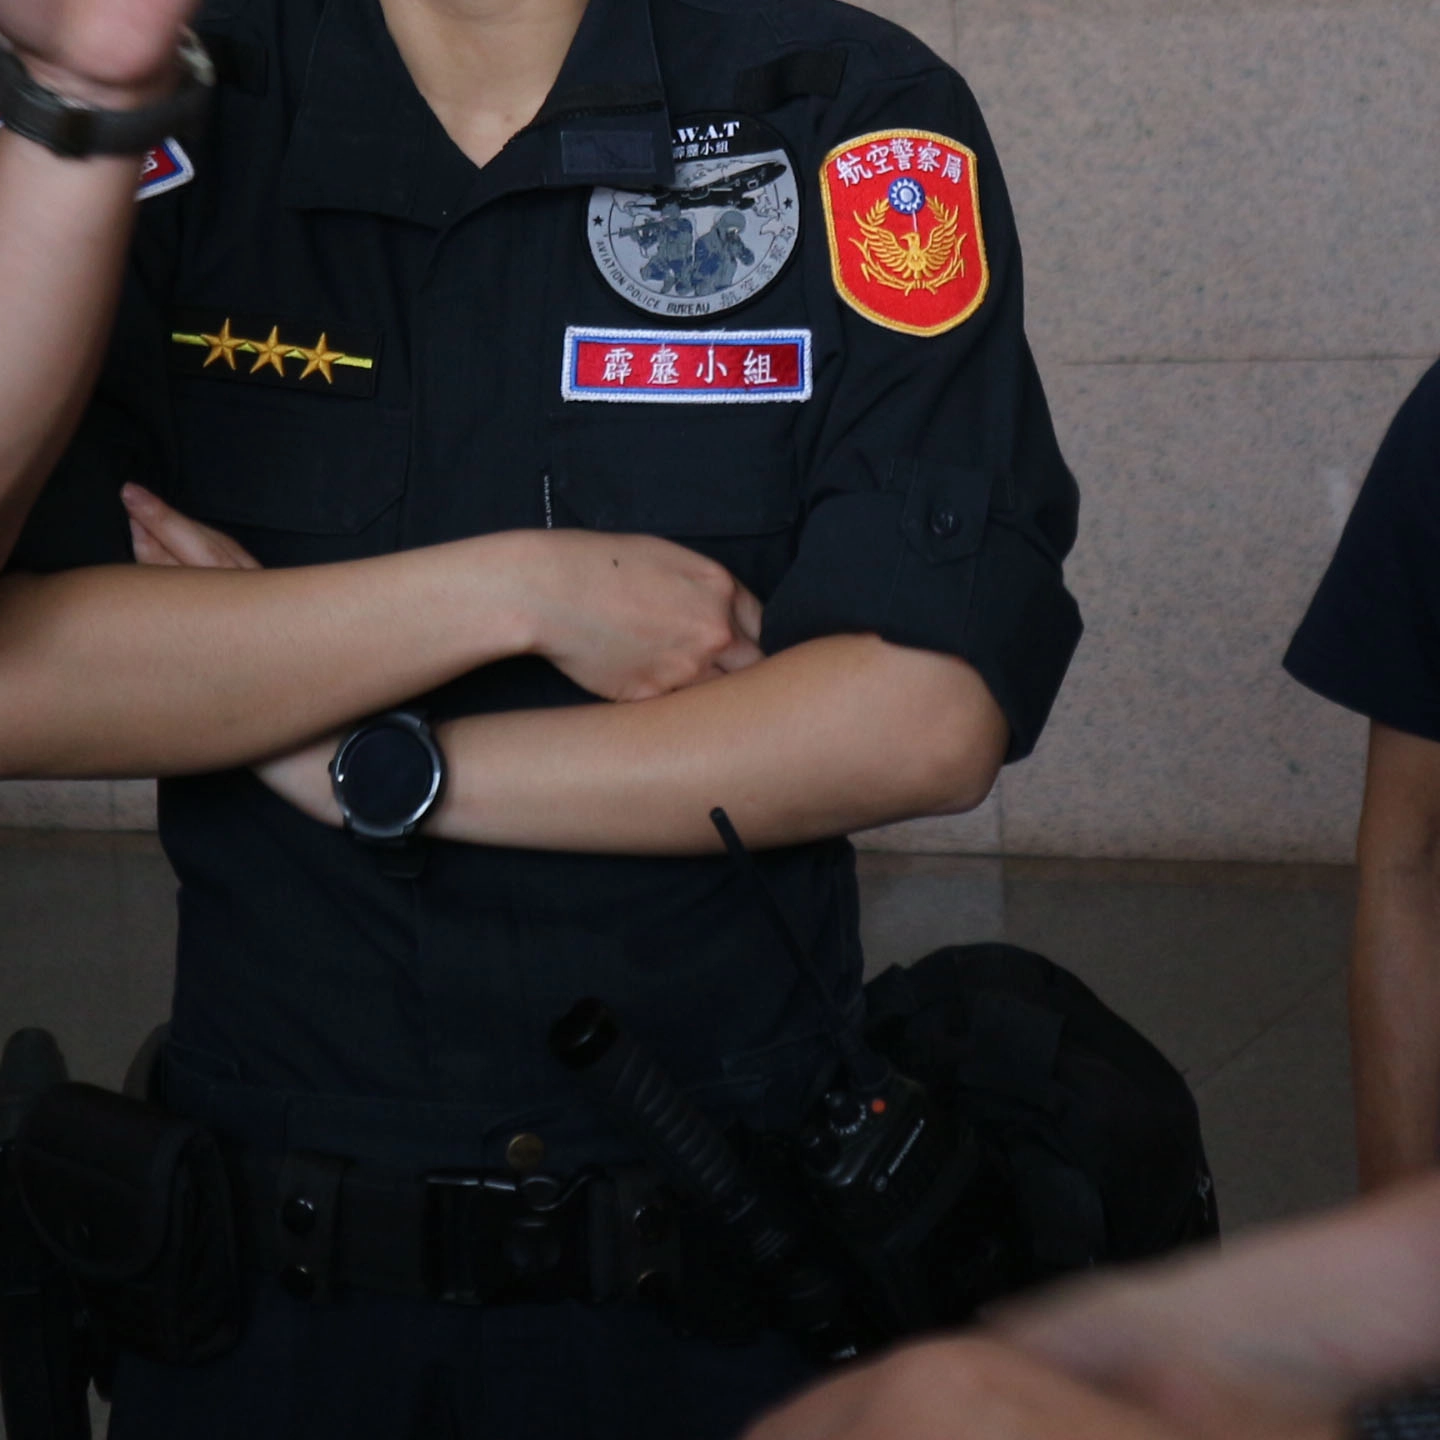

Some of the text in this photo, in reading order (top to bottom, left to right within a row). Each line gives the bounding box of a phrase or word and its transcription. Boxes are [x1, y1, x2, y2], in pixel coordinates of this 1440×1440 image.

[671, 121, 740, 144] .W.A.T
[835, 137, 963, 188] 航空警察局
[595, 240, 710, 315] AVIATION POLICE BUREAU
[601, 347, 778, 386] 霹靂小組
